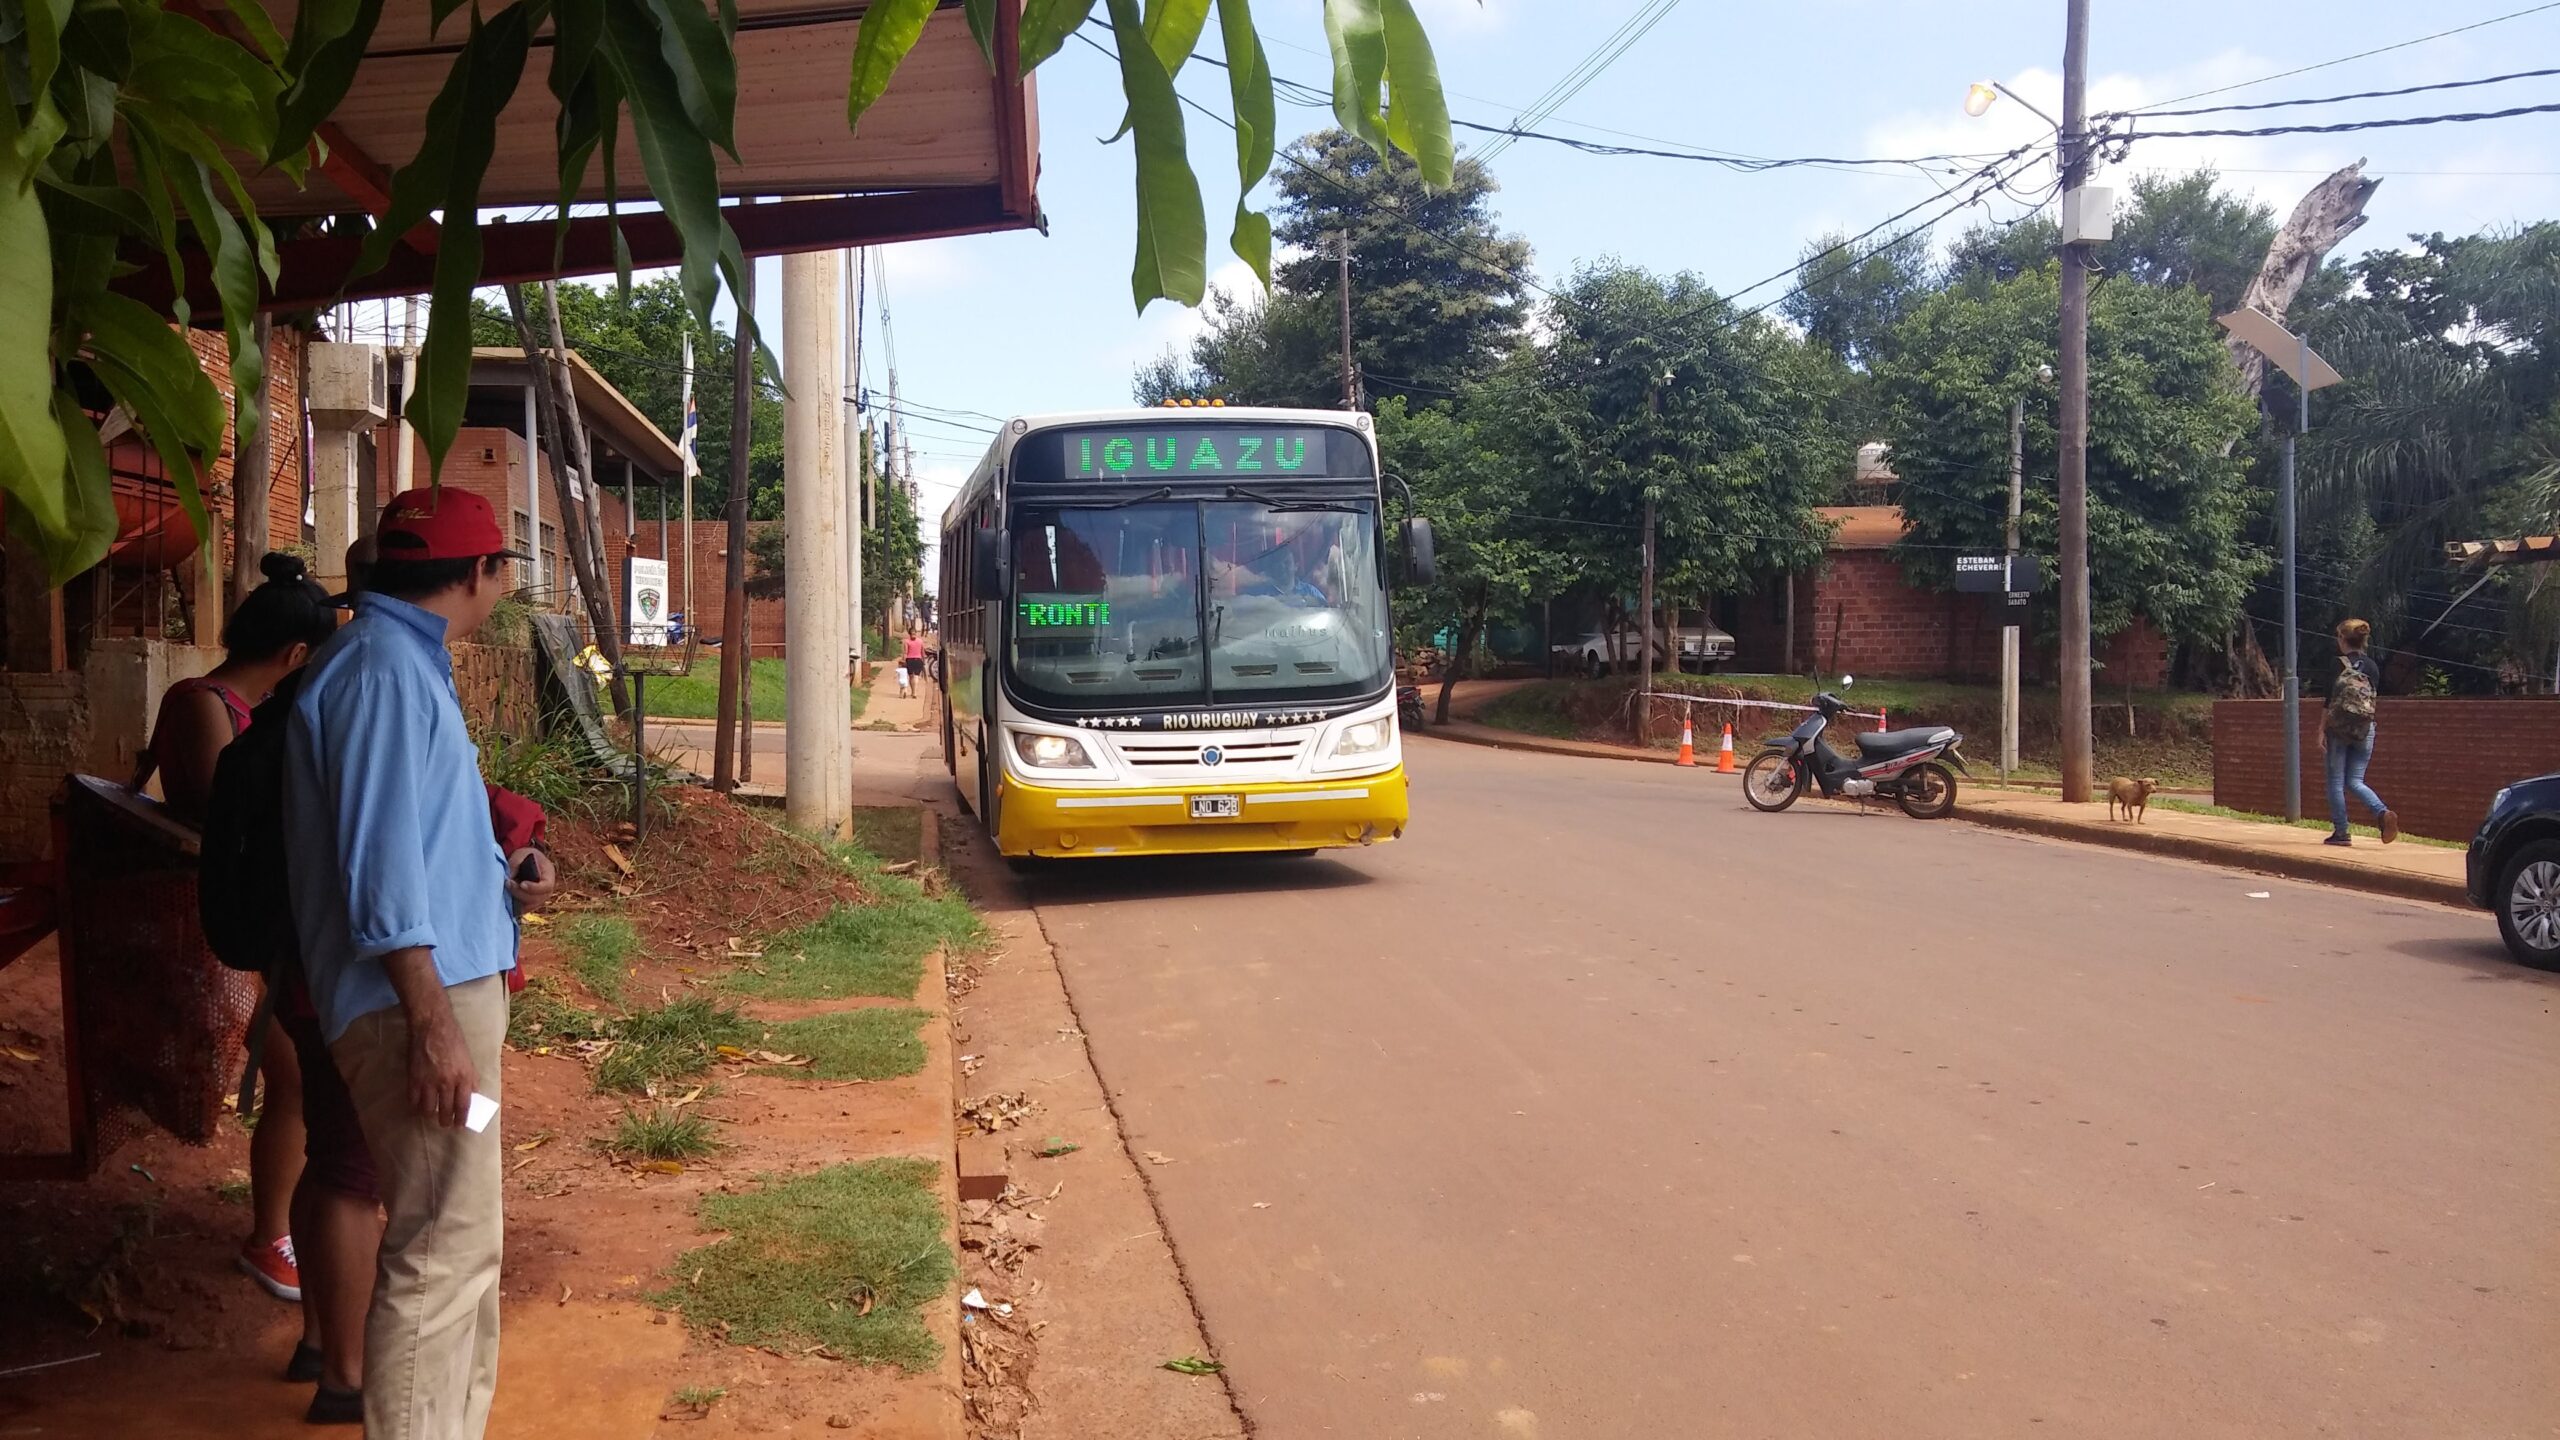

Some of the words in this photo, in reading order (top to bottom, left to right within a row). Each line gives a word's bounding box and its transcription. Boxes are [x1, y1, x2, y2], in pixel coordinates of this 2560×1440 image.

[1079, 436, 1306, 472] IGUAZU
[1163, 714, 1189, 729] RIO
[1191, 712, 1259, 728] URUGUAY
[1217, 799, 1238, 813] 628
